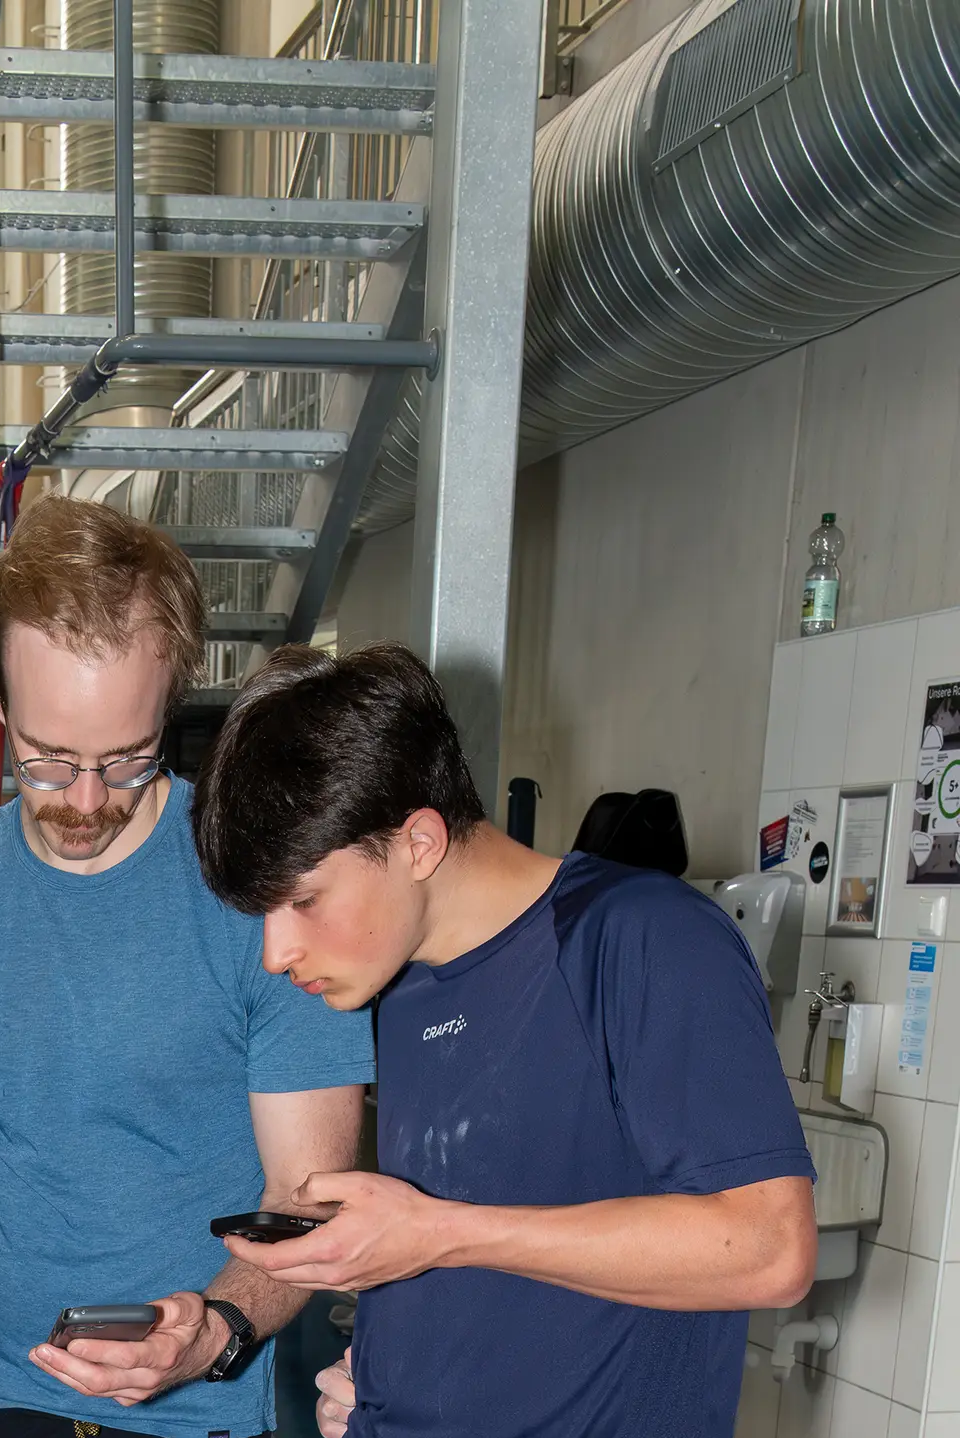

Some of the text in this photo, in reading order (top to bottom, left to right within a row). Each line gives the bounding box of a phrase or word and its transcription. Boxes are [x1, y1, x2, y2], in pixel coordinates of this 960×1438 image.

[929, 689, 951, 699] Unsere
[949, 780, 959, 793] 5+
[423, 1020, 456, 1041] CRAFT
